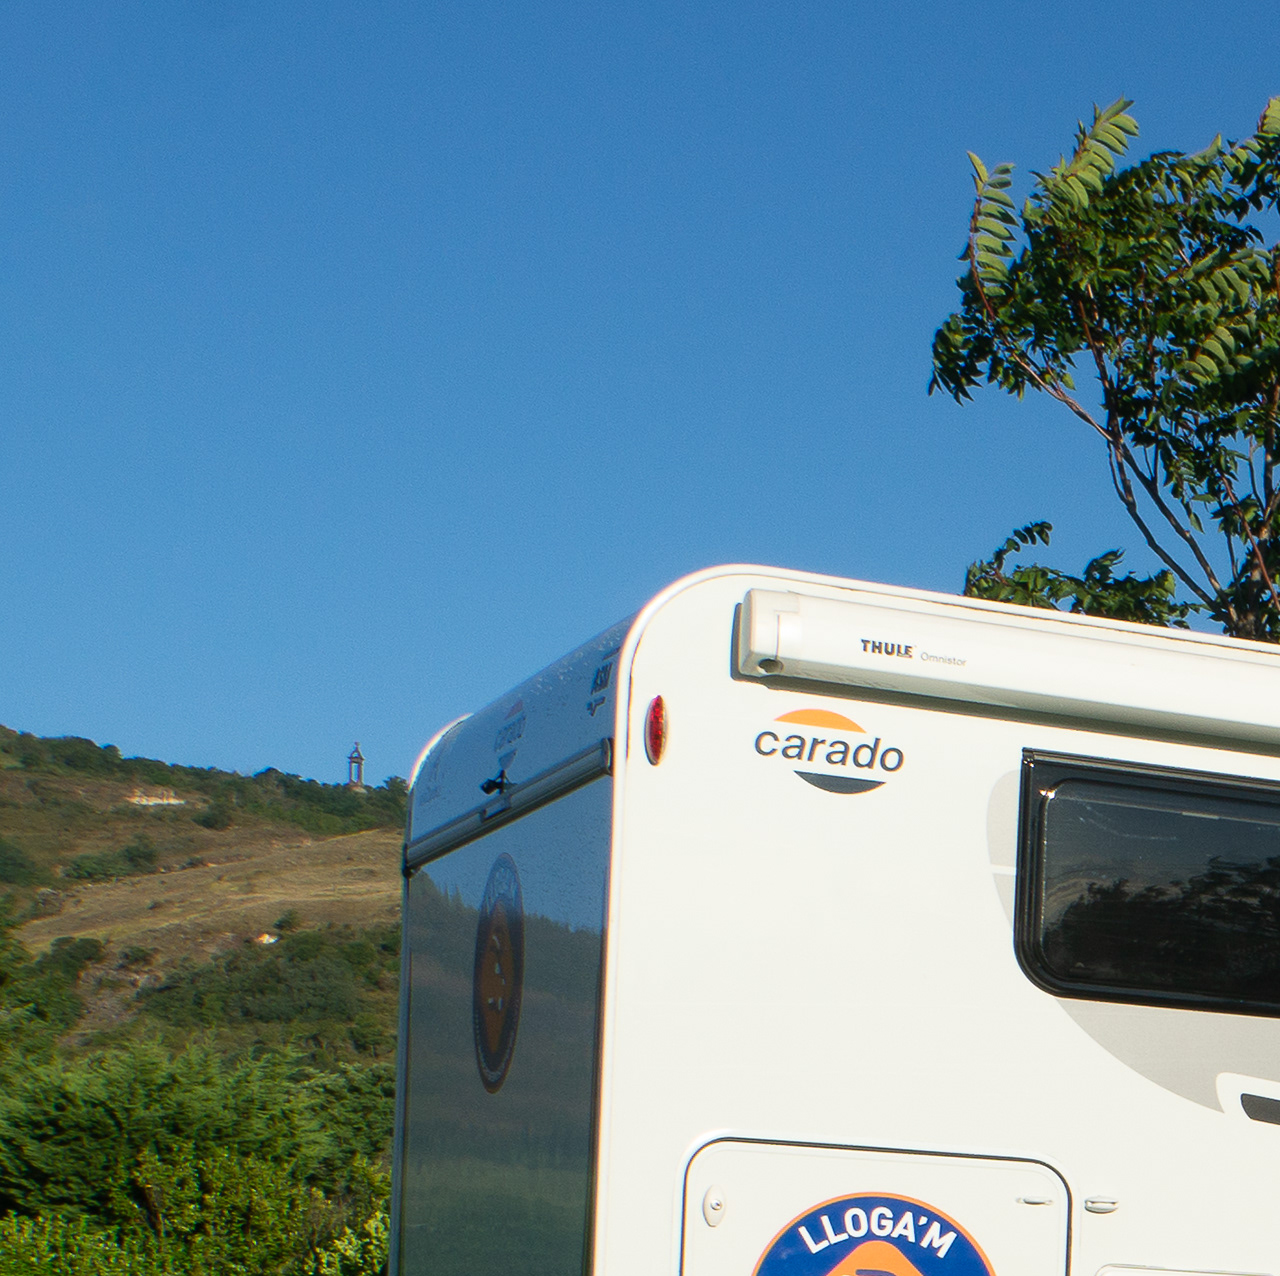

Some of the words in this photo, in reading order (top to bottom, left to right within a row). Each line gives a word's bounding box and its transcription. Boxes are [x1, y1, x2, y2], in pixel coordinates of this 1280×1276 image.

[860, 638, 914, 659] THULE
[920, 651, 967, 668] Omnistor
[754, 729, 905, 772] carado
[798, 1206, 957, 1259] LLOGA'M
